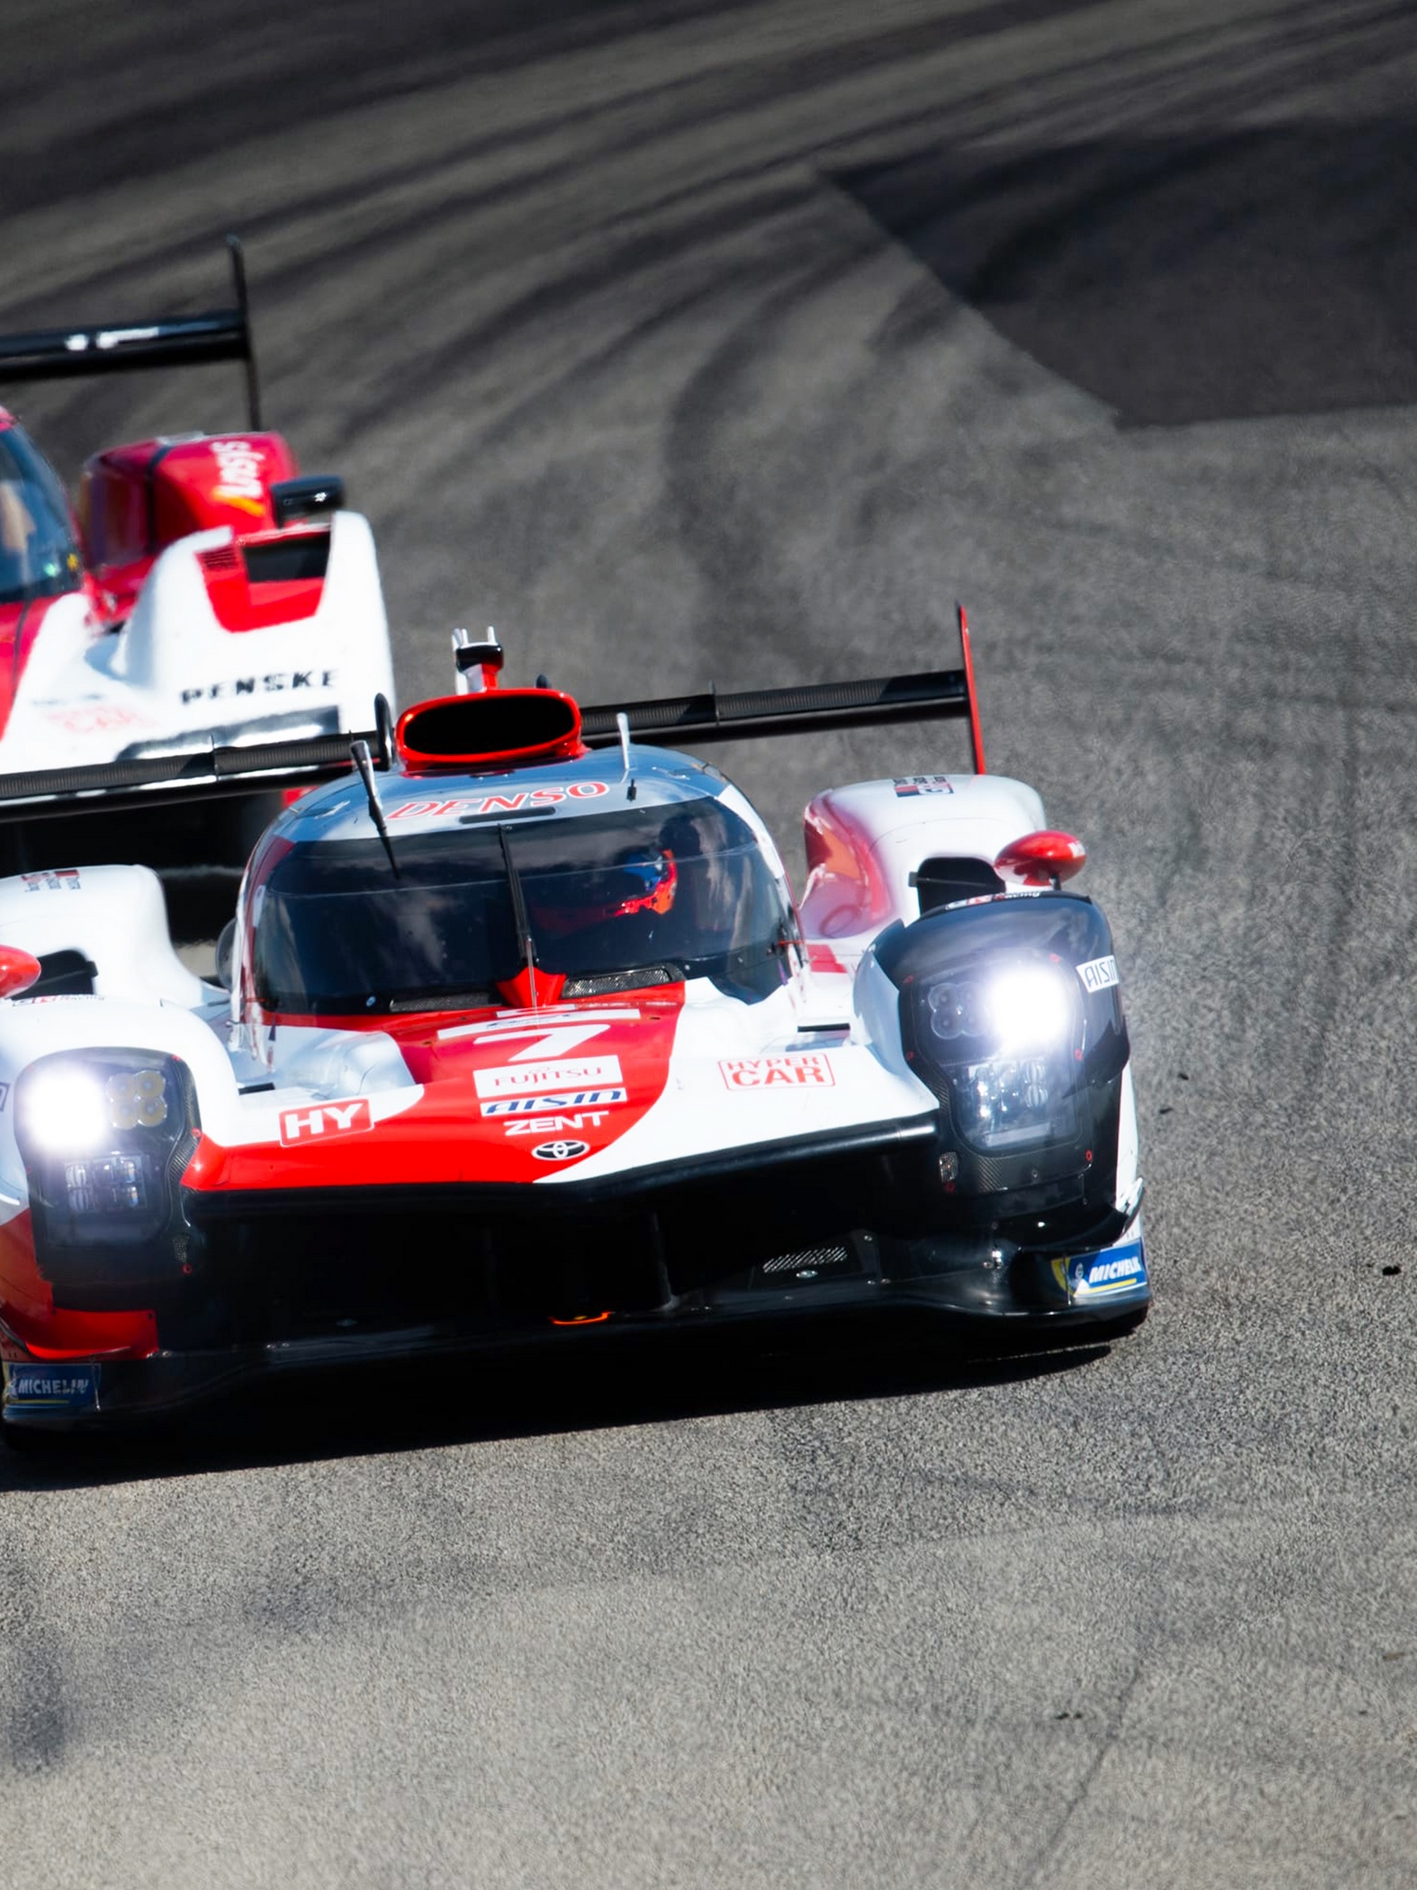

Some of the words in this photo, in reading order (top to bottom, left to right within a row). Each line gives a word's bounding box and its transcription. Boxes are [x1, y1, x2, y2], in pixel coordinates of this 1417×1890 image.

[181, 669, 338, 704] PENSKE
[384, 780, 610, 820] DENSO
[473, 1023, 611, 1062] 7
[494, 1066, 602, 1087] FUJITSU
[727, 1057, 819, 1070] HYPER
[732, 1066, 825, 1086] CAR
[486, 1090, 622, 1114] AISIN
[285, 1103, 364, 1139] HY
[503, 1110, 609, 1137] ZENT
